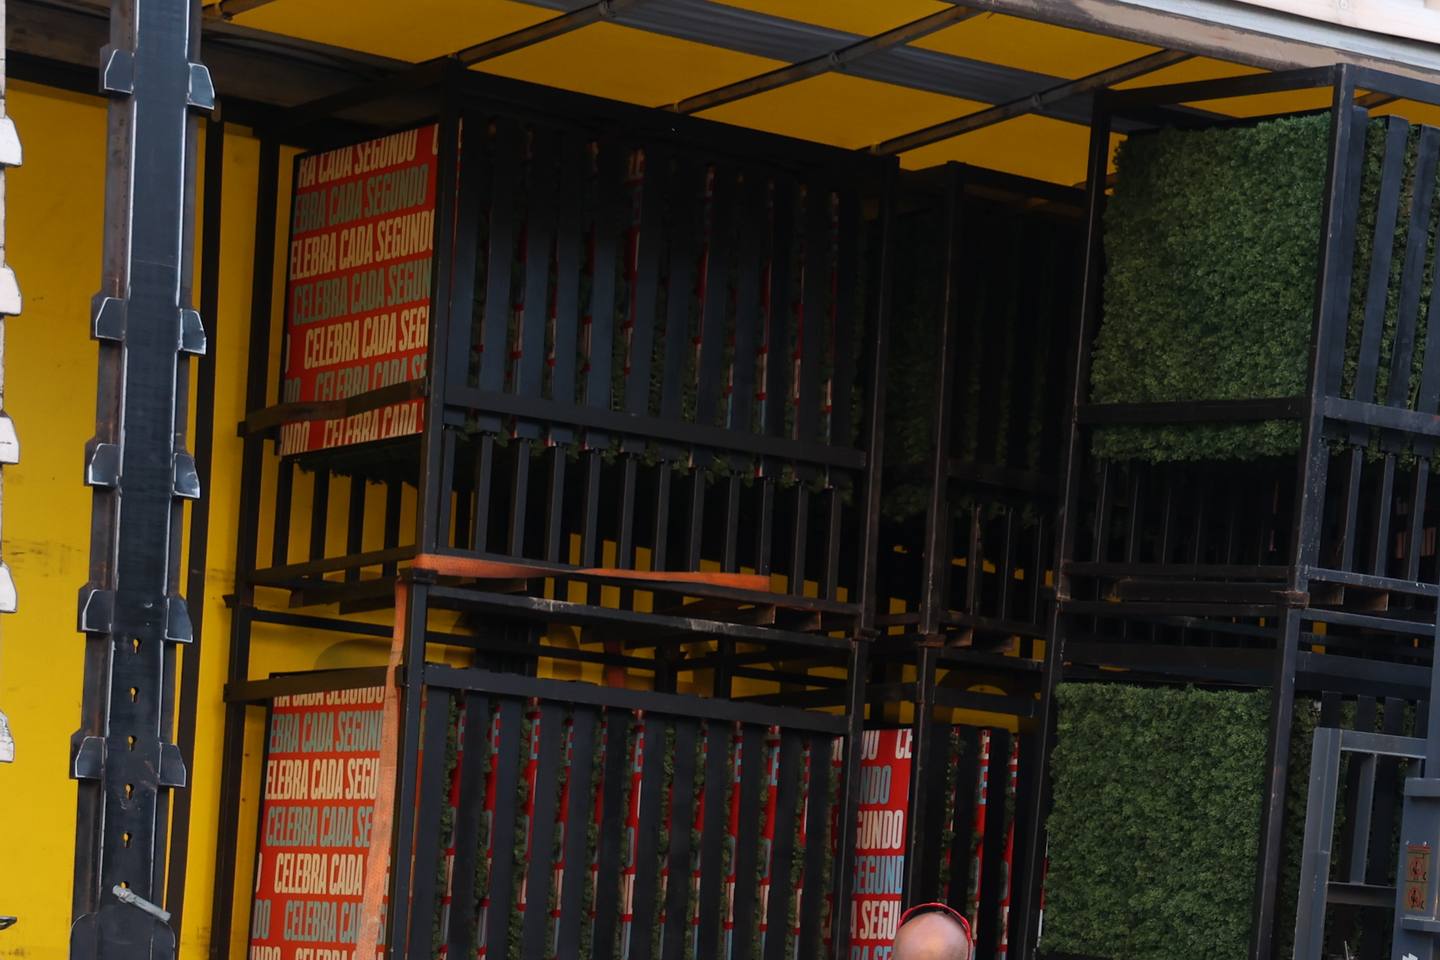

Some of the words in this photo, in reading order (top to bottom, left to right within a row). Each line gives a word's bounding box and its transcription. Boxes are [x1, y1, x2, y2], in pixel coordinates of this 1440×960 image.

[329, 179, 364, 226] CADA
[364, 163, 429, 217] SEGUNDO
[338, 224, 373, 270] CADA
[293, 273, 348, 326] CELEBRA
[350, 268, 385, 314] CADA
[303, 319, 360, 370] CELEBRA
[361, 312, 397, 359] CADA
[301, 711, 334, 753] CADA
[265, 759, 309, 800] ELEBRA
[310, 758, 344, 800] CADA
[266, 806, 318, 847] CELEBRA
[319, 806, 354, 847] CADA
[273, 852, 328, 895] CELEBRA
[328, 853, 364, 896] CADA
[283, 899, 337, 943] CELEBRA
